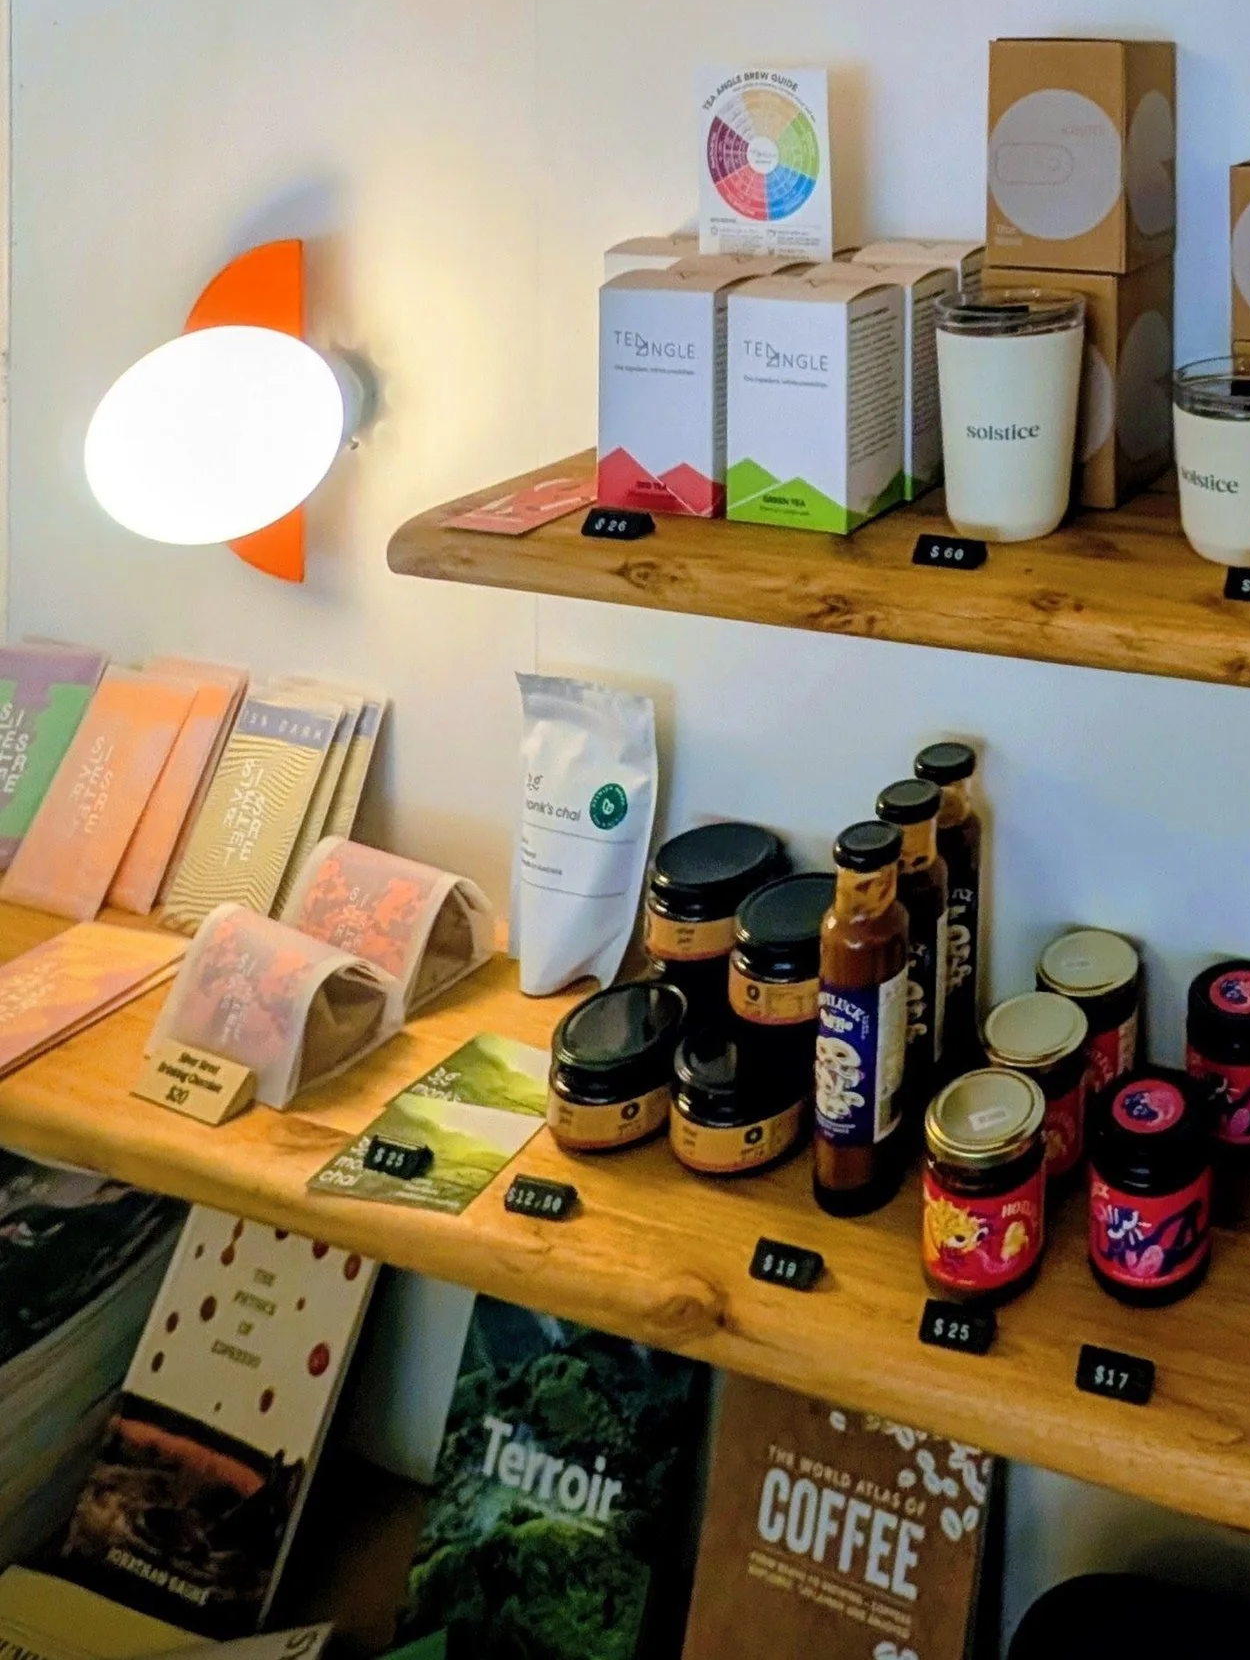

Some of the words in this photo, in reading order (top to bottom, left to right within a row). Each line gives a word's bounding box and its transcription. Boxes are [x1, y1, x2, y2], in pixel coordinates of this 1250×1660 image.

[743, 70, 769, 82] BREW
[770, 73, 799, 92] GUIDE
[966, 422, 1041, 442] solstice
[525, 799, 554, 816] onk's
[555, 807, 582, 822] chai
[319, 1170, 360, 1187] chai
[483, 1414, 623, 1523] Terroir
[768, 1443, 796, 1468] THE
[800, 1456, 850, 1489] WORLD
[855, 1479, 901, 1509] ATLAS
[904, 1496, 927, 1518] OF
[758, 1466, 926, 1602] COFFEE
